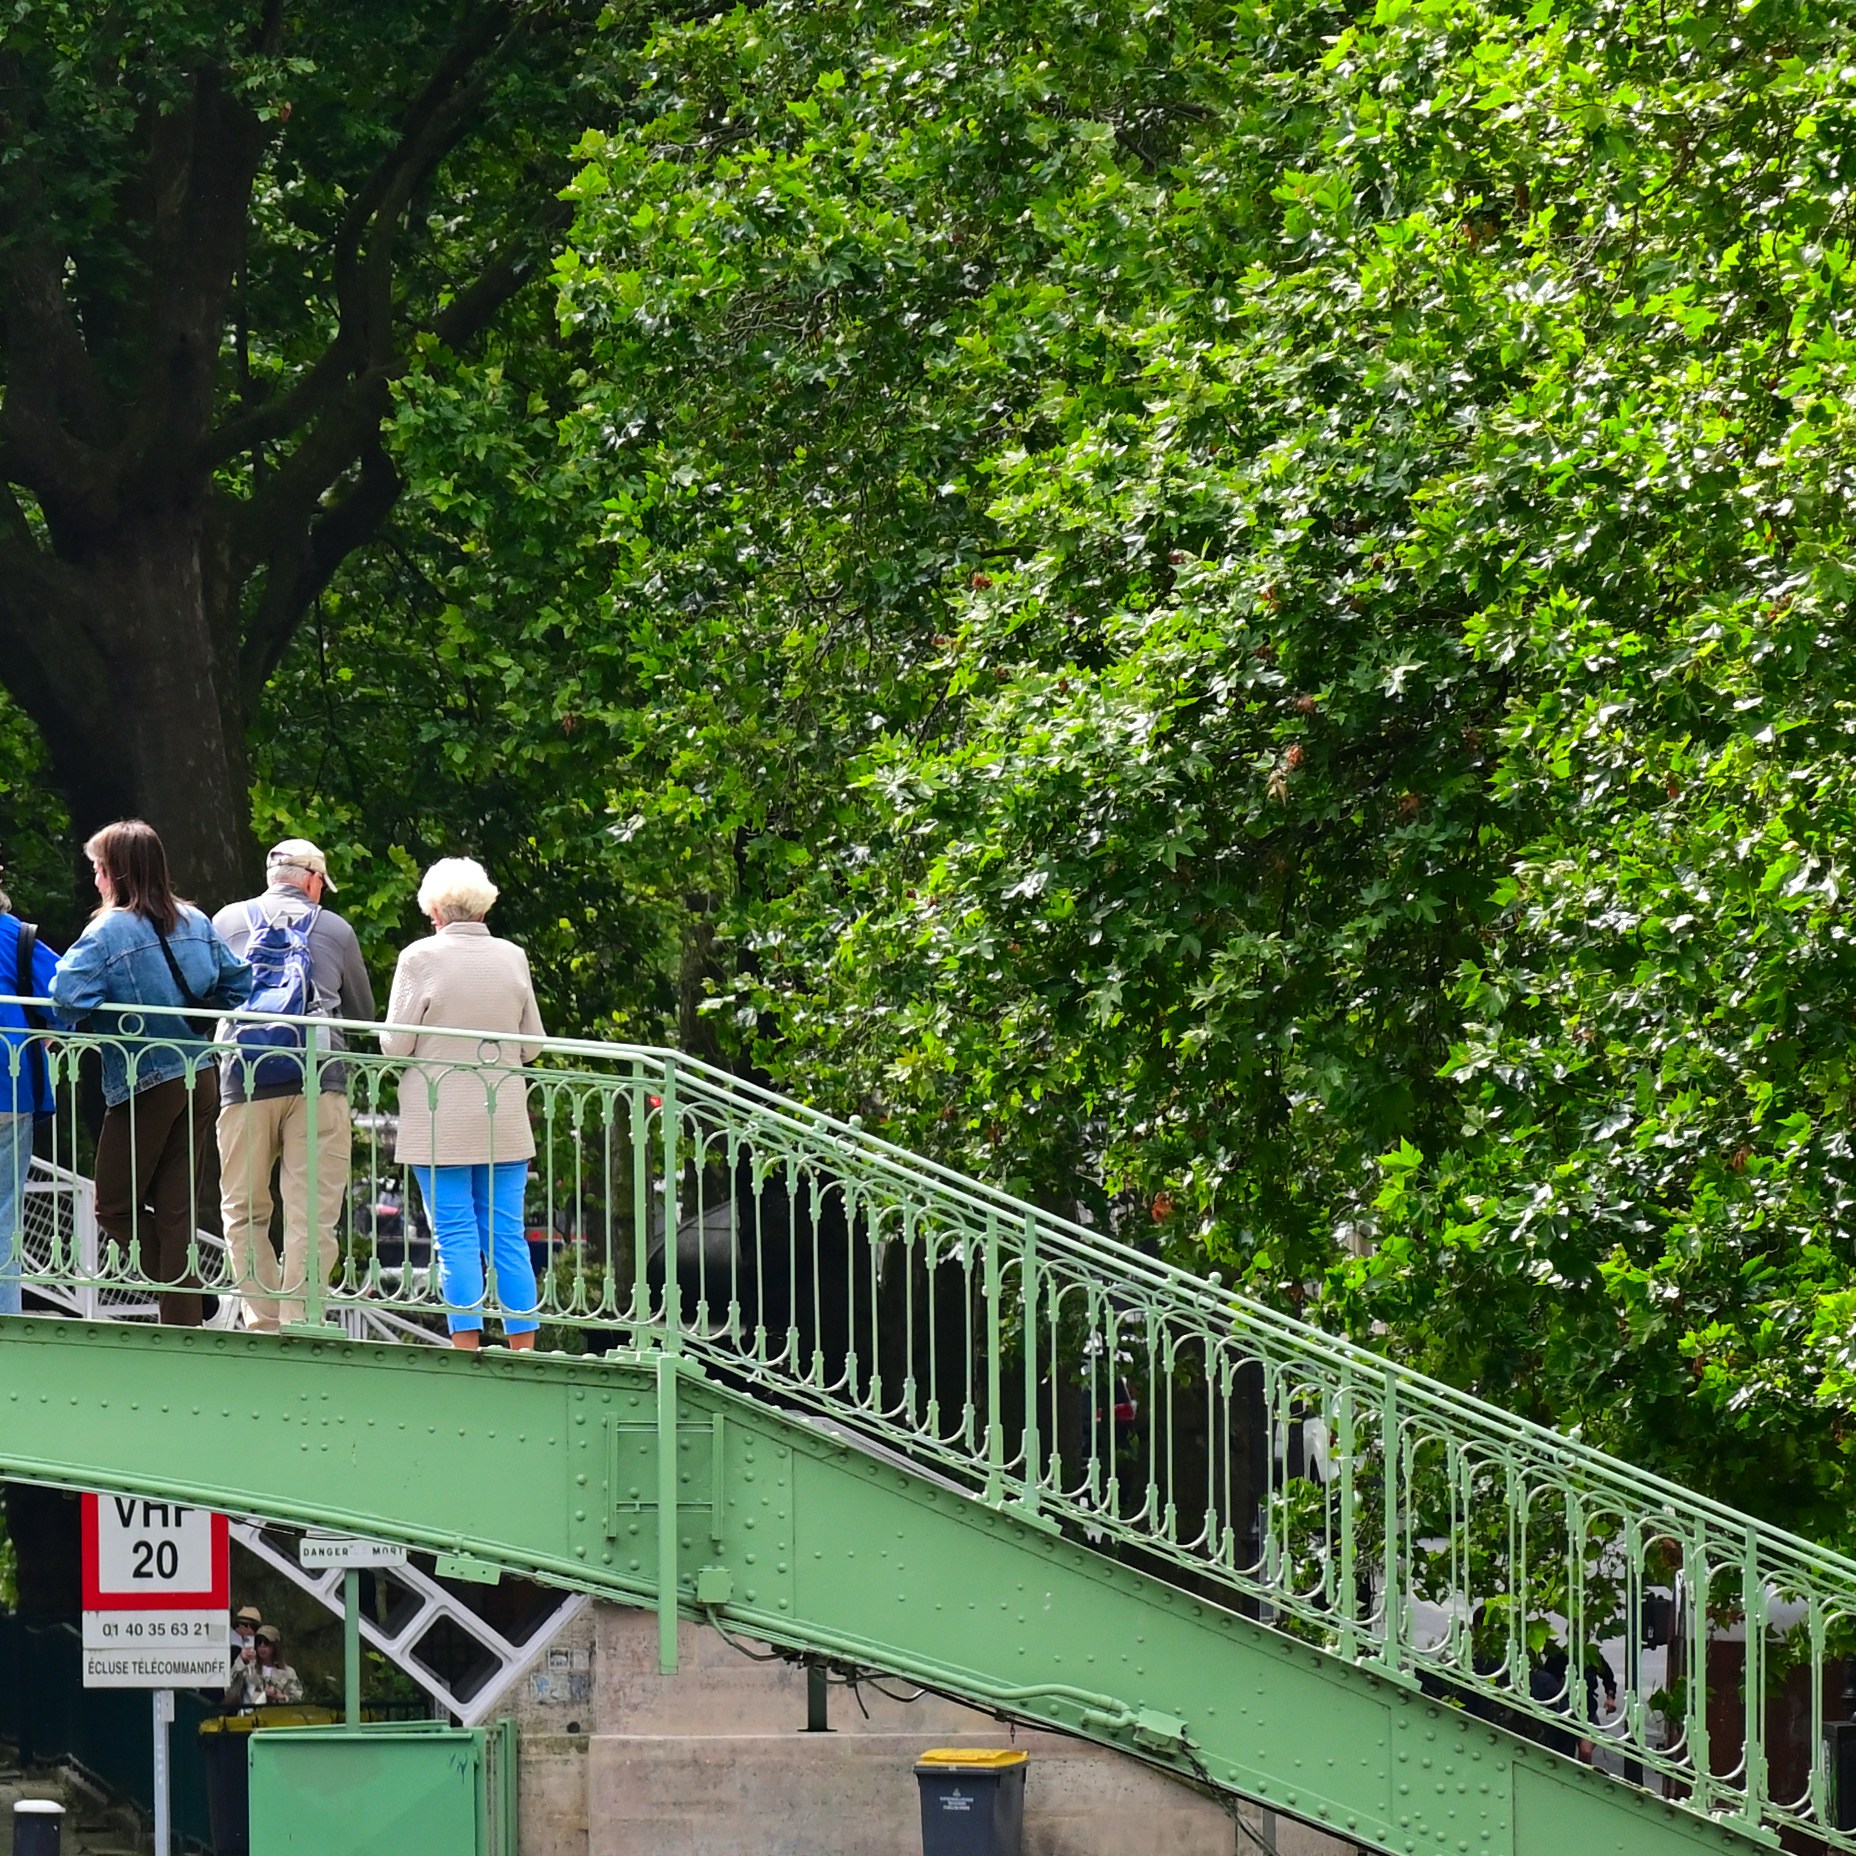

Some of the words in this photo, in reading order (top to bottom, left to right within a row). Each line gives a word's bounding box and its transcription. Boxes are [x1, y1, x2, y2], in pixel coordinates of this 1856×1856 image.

[132, 1540, 178, 1579] 20
[303, 1547, 349, 1557] DANGER
[102, 1623, 119, 1637] 01
[125, 1623, 144, 1637] 40
[148, 1623, 166, 1637] 35
[170, 1623, 189, 1637] 63
[194, 1623, 210, 1637] 21
[88, 1657, 129, 1675] ÉCLUSE
[132, 1657, 225, 1676] TÉLÉCOMMANDÉE
